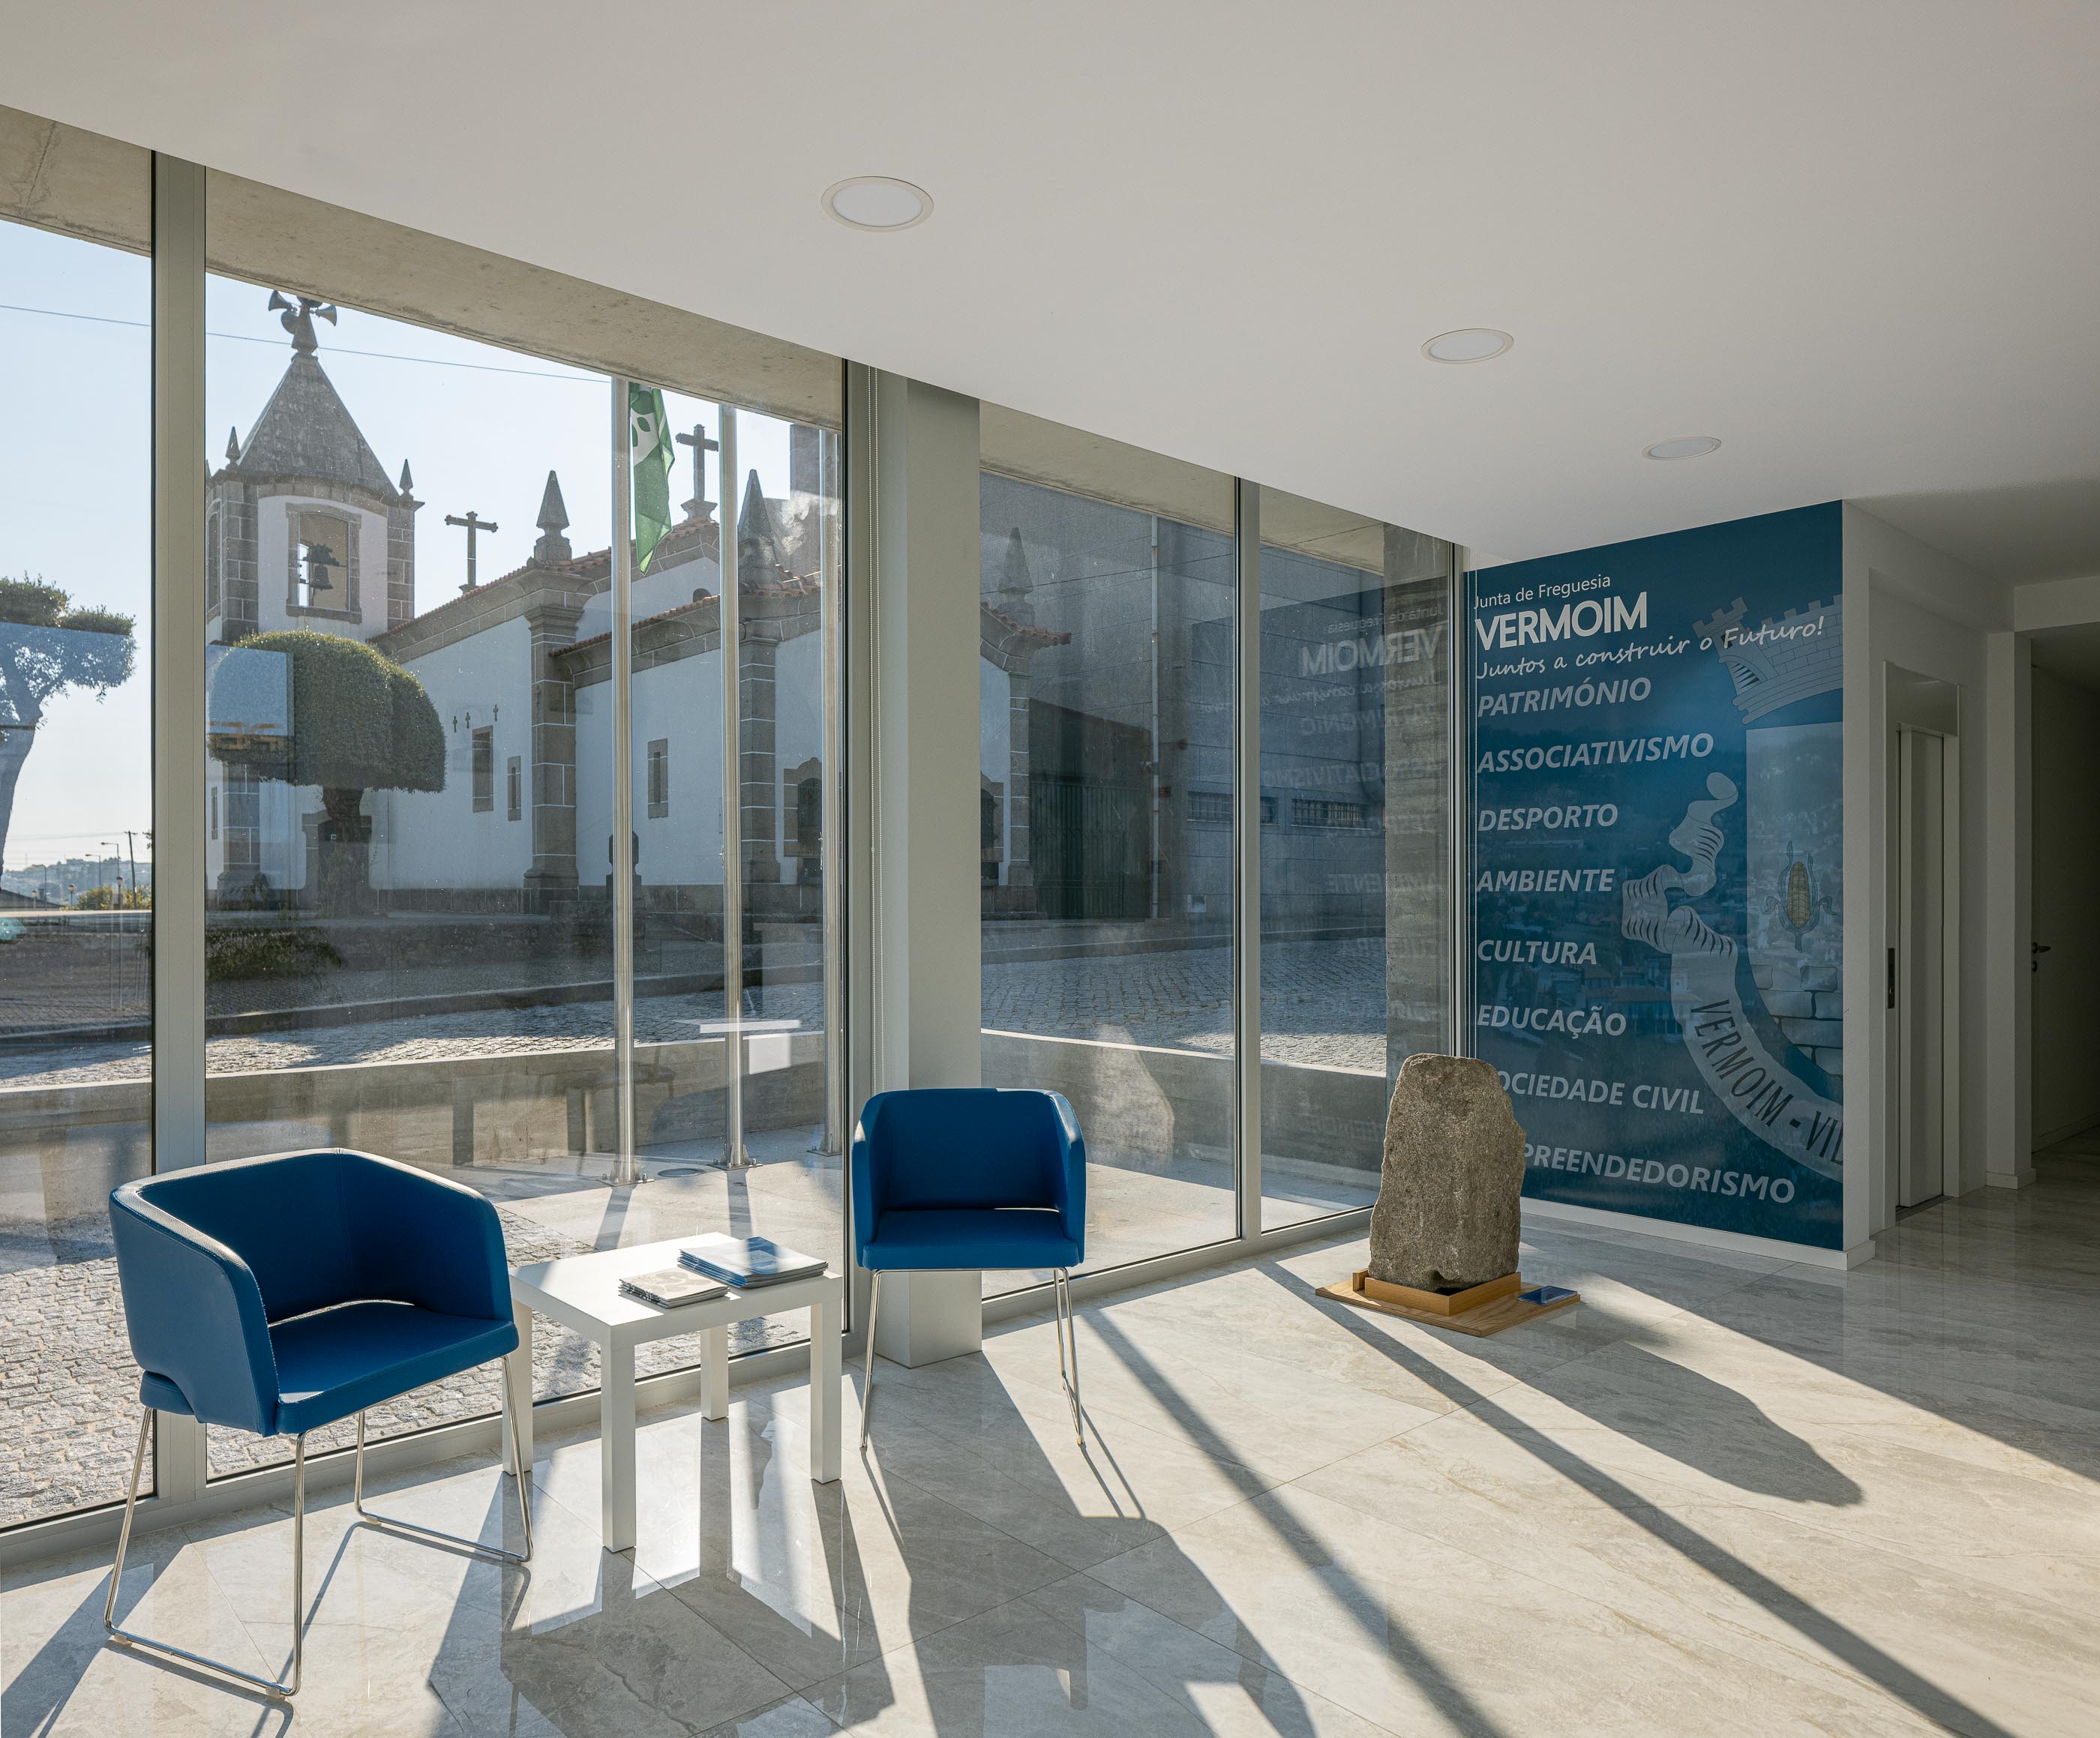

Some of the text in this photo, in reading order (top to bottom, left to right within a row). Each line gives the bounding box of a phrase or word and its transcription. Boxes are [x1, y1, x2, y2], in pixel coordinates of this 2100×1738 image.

[1474, 574, 1611, 610] Junta de Freguesia
[1474, 591, 1648, 651] VERMOIM
[1476, 616, 1826, 679] Juntos a construir o Futuro!
[1478, 676, 1652, 718] PATRIMÓNIO
[1477, 732, 1714, 774] ASSOCIATIVISMO
[1477, 803, 1618, 832] DESPORTO
[1476, 868, 1616, 893] AMBIENTE
[1477, 939, 1598, 966] CULTURA
[1477, 1005, 1627, 1039] EDUCAÇÃO
[1690, 999, 1794, 1127] VERMOIM
[1497, 1070, 1705, 1115] OCIEDADE CIVIL
[1524, 1142, 1796, 1204] PREENDEDORISMO
